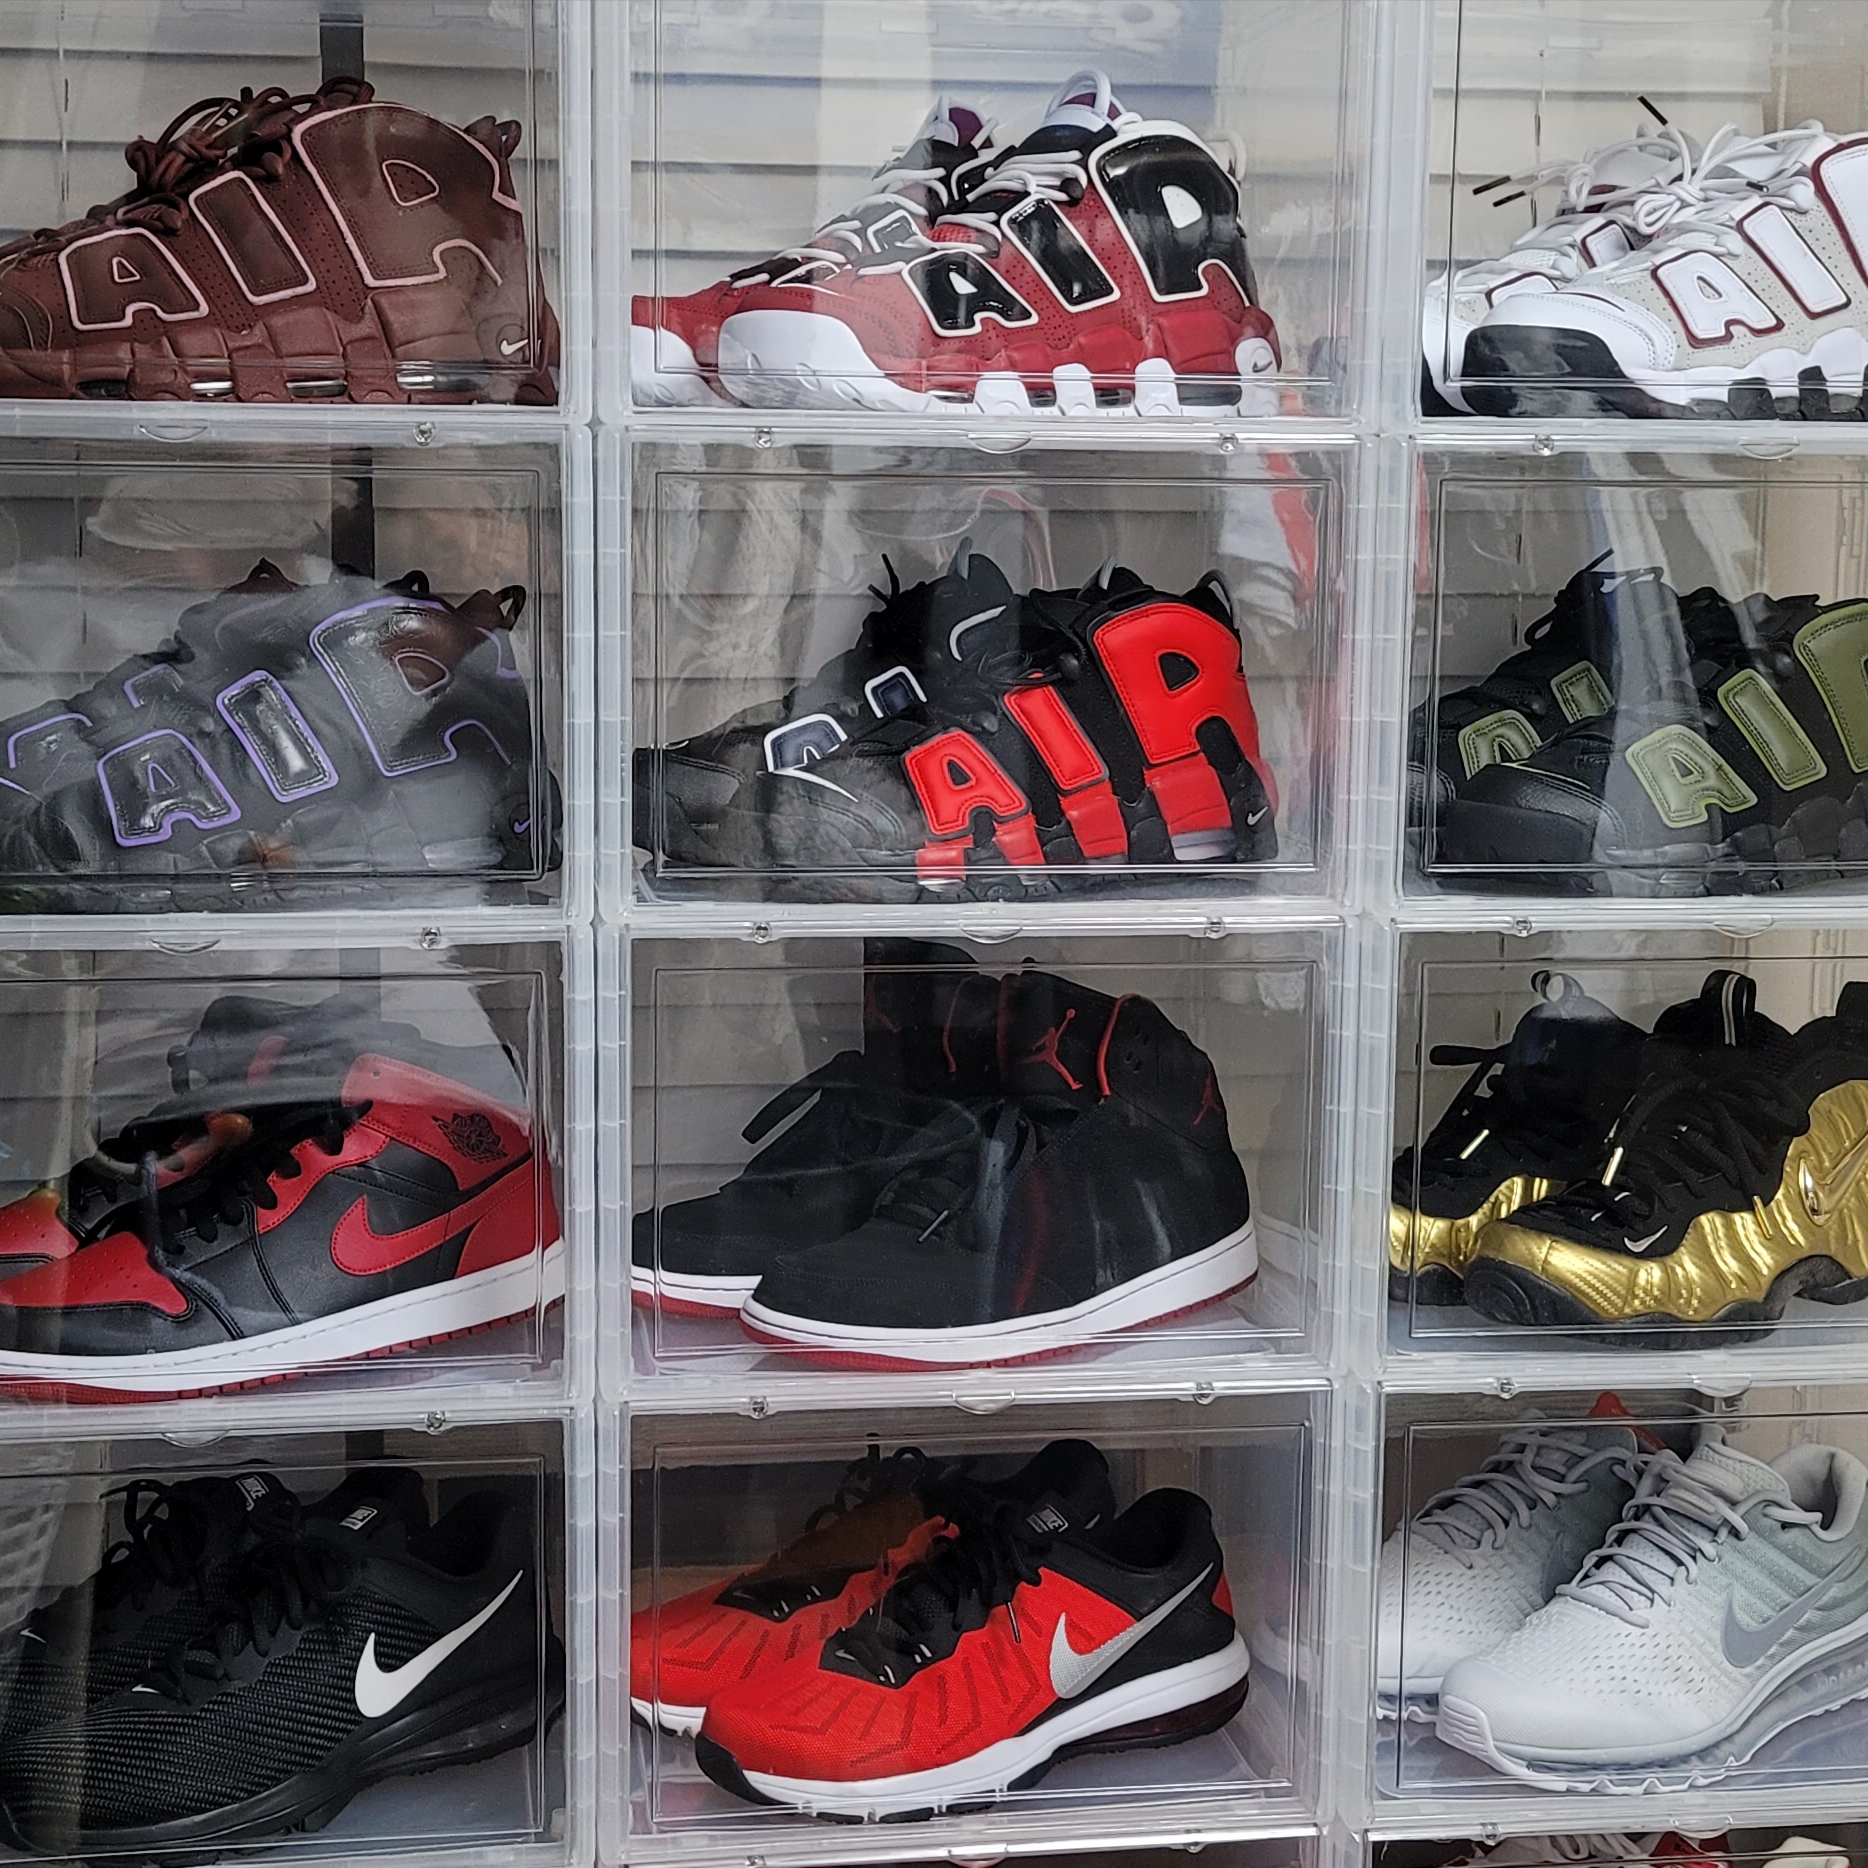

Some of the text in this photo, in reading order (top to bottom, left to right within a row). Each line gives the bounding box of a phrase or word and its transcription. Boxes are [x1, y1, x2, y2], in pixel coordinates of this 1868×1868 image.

[58, 102, 522, 331] AIR
[902, 120, 1256, 337] AIR
[97, 596, 519, 847] AIR
[903, 602, 1262, 841] AIR
